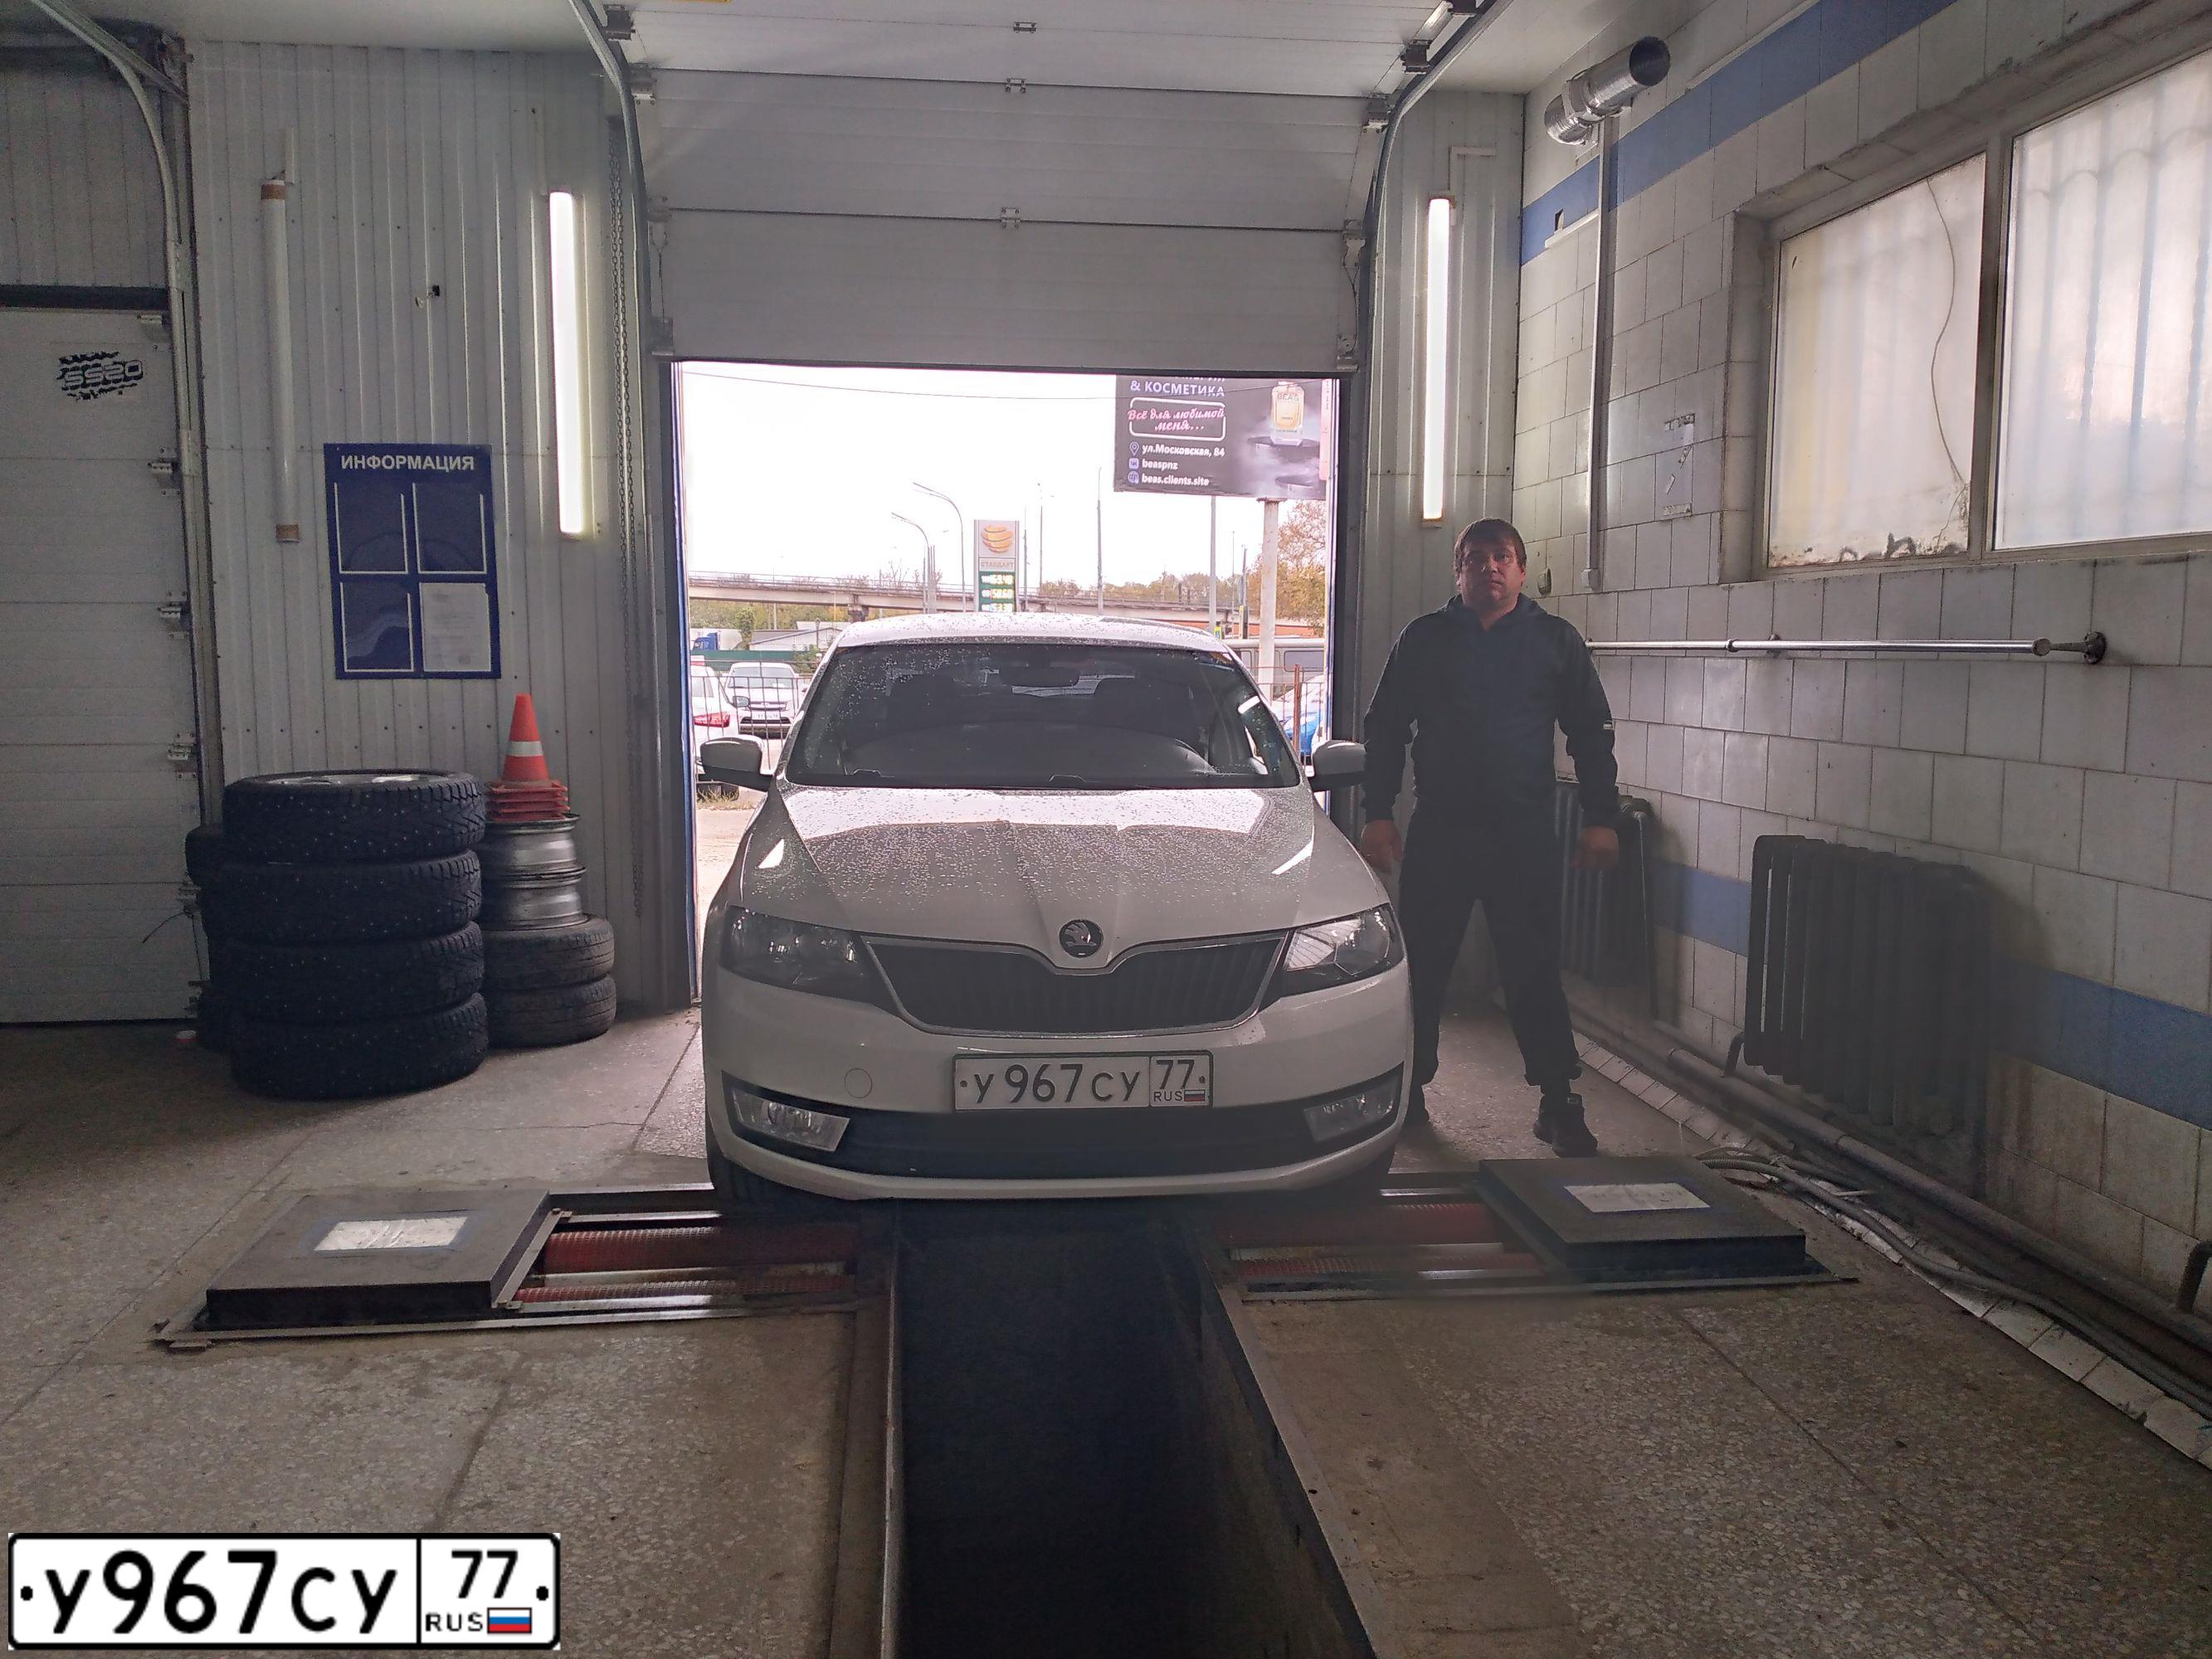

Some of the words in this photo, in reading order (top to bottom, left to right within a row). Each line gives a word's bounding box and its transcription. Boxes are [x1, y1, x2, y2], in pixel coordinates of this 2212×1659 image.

[1130, 380, 1141, 392] &
[1144, 382, 1225, 397] КОСМЕТИКА
[1128, 409, 1147, 421] Всё
[1150, 408, 1172, 420] для
[1172, 407, 1225, 419] любимой
[1213, 447, 1225, 457] 84
[341, 455, 475, 472] ИНФОРМАЦИЯ
[1142, 459, 1178, 470] beaspnz
[1142, 474, 1210, 486] beas.clients.site
[1156, 1059, 1195, 1089] 77
[1153, 1091, 1183, 1102] RUS
